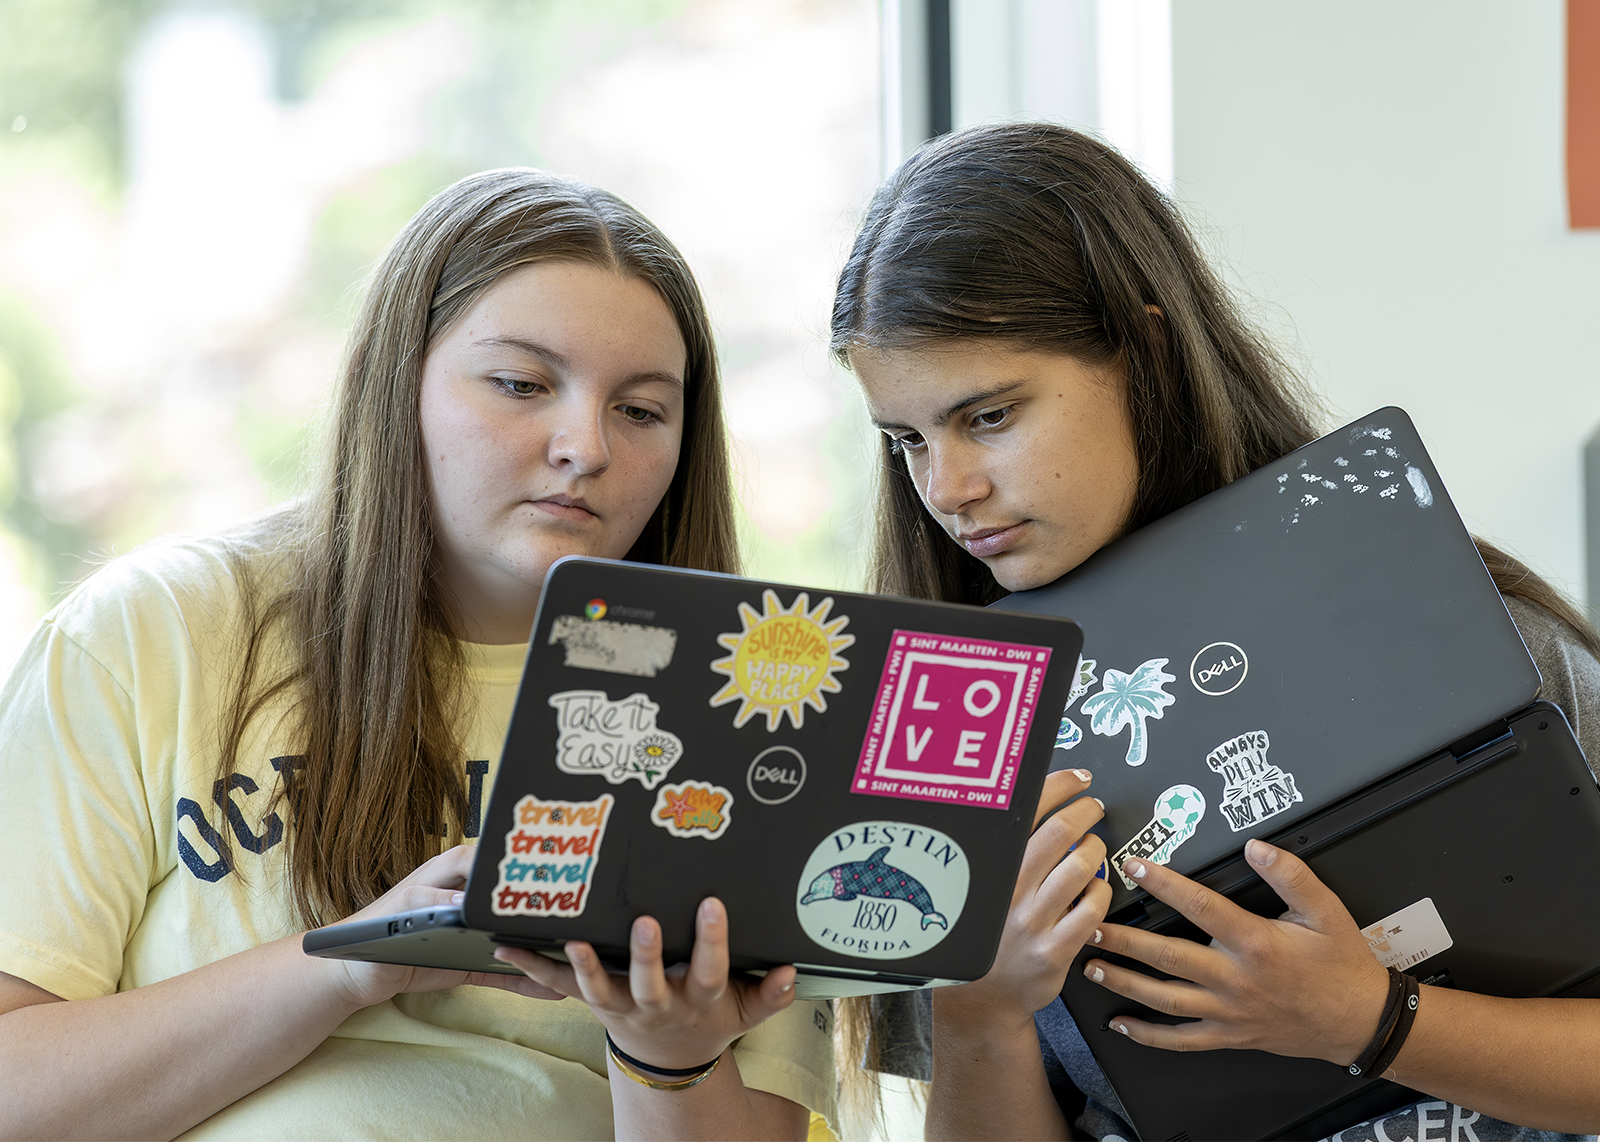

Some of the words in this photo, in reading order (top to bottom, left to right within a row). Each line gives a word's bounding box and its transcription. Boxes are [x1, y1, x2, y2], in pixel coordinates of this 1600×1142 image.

[909, 637, 938, 651] SINT
[939, 640, 997, 657] MAARTEN
[1006, 648, 1032, 661] DWI
[746, 659, 818, 686] HAPPY
[1197, 655, 1242, 684] DELL
[750, 679, 802, 701] PLACE
[1023, 666, 1042, 706] SAINT
[552, 694, 624, 739] Take
[622, 697, 654, 732] it
[861, 736, 880, 775] SAINT
[876, 683, 894, 736] MARTIN
[888, 650, 903, 675] FWI
[1010, 706, 1031, 757] MARTIN
[560, 734, 633, 779] Easy
[1208, 733, 1266, 771] ALWAYS
[754, 765, 799, 785] DELL
[1000, 765, 1015, 790] FWI
[1223, 750, 1265, 786] PLAY
[870, 780, 899, 793] SINT
[900, 784, 958, 799] MAARTEN
[967, 792, 992, 803] DWI
[1222, 775, 1297, 829] WIN
[519, 799, 609, 827] travel
[511, 828, 599, 856] travel
[833, 825, 958, 869] DESTIN
[504, 856, 593, 884] travel
[498, 884, 586, 912] travel
[851, 899, 898, 933] 1850
[820, 927, 912, 951] FLORIDA
